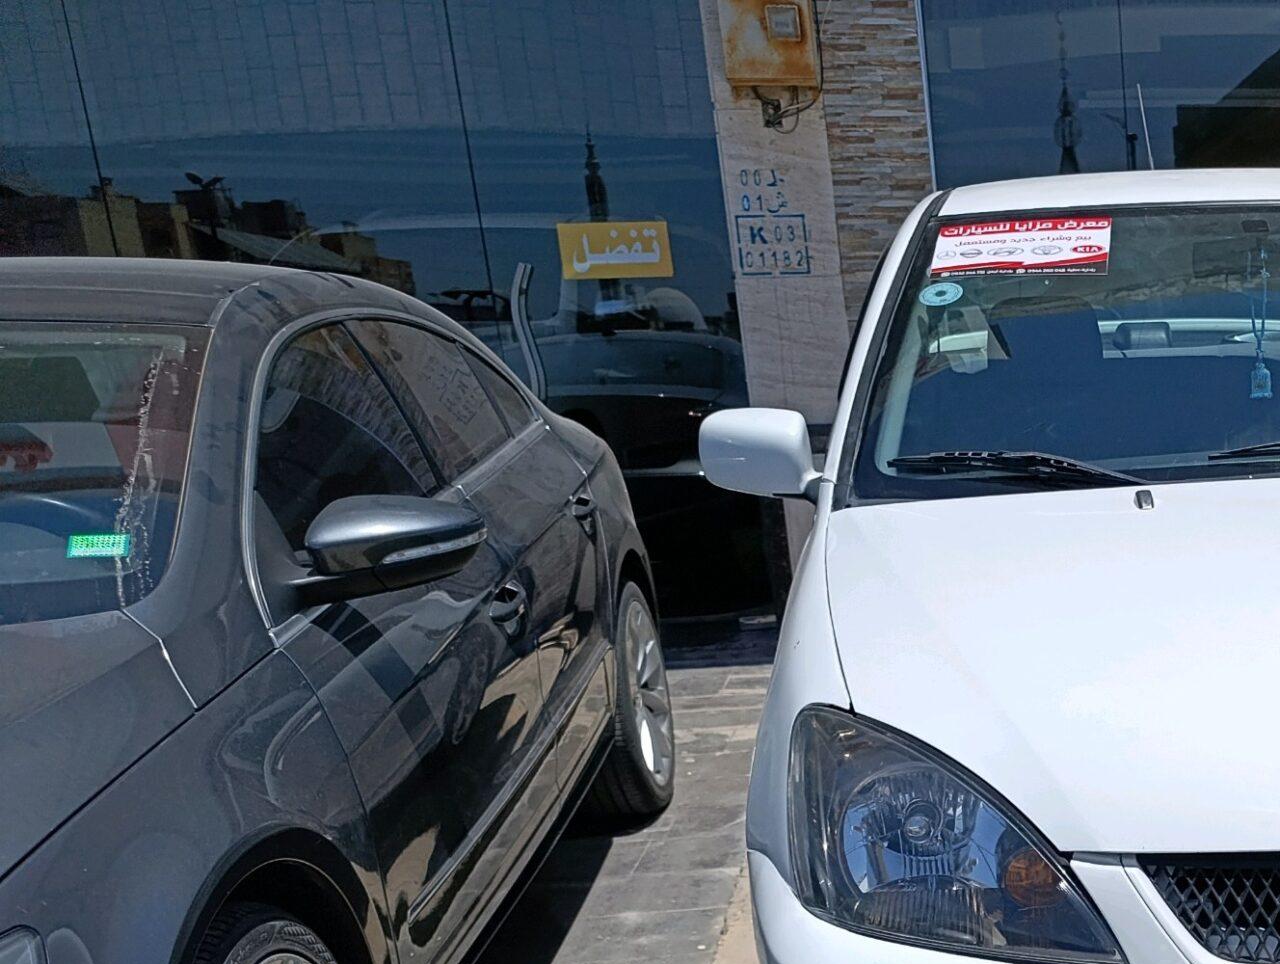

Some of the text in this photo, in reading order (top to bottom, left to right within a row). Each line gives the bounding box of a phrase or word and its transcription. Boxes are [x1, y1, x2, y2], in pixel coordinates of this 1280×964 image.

[749, 225, 796, 244] K 03
[943, 219, 1109, 236] معرض مزايا للسيارات
[573, 228, 660, 273] تفضل
